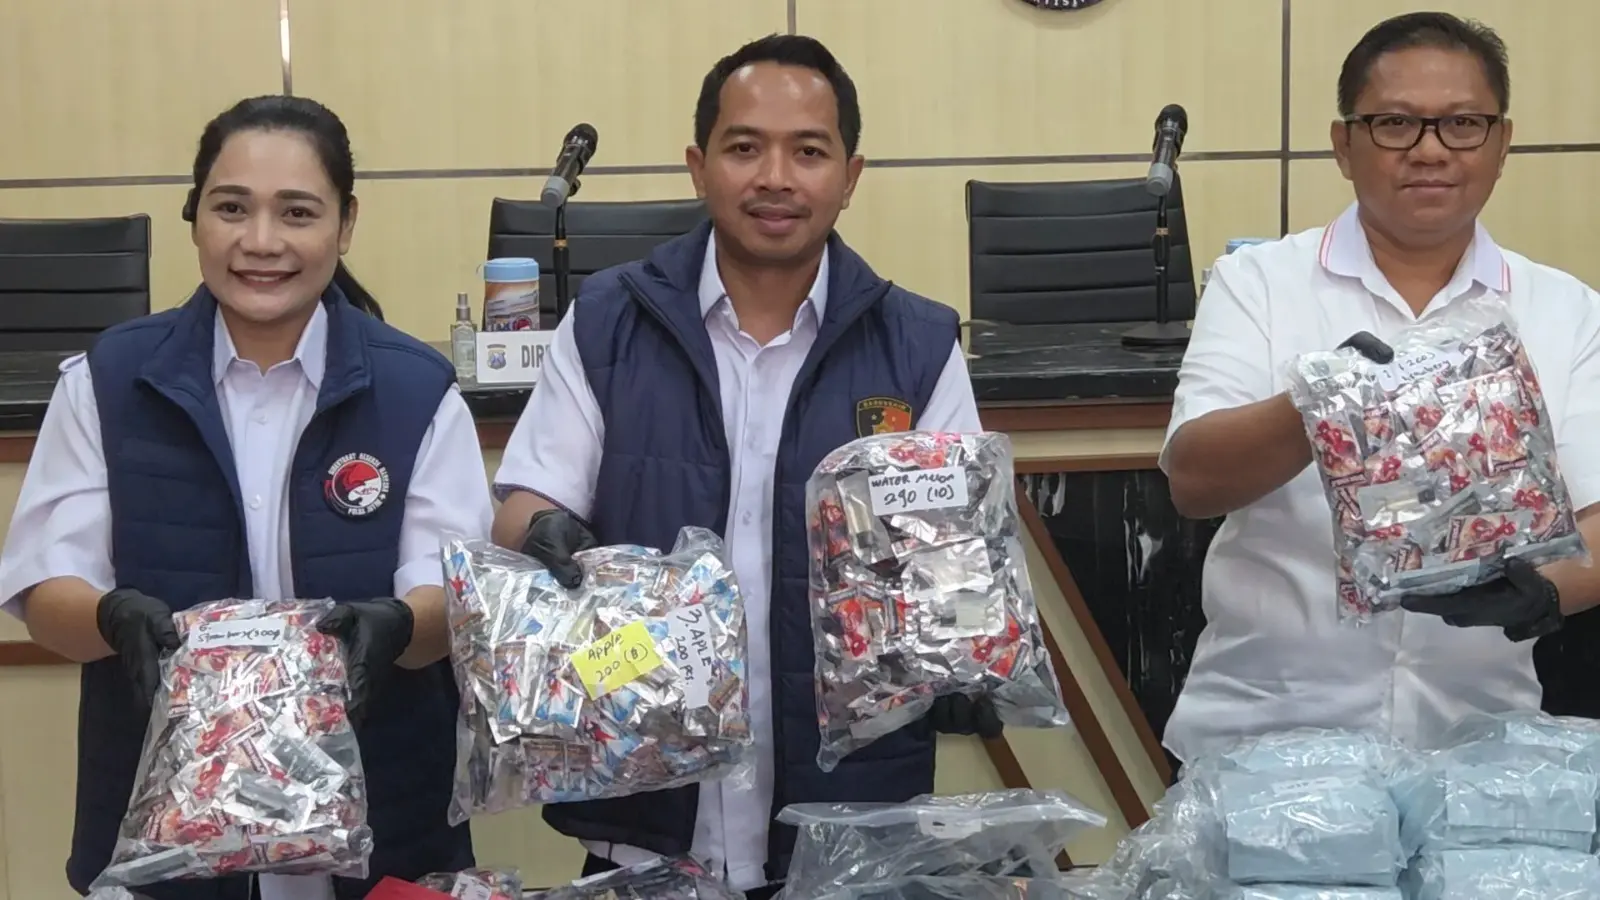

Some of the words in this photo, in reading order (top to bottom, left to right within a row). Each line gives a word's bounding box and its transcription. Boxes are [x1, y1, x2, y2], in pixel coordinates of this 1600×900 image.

[871, 474, 910, 487] WATER
[883, 488, 917, 508] 290
[927, 484, 955, 502] (10)
[676, 608, 703, 627] 3.
[588, 633, 624, 661] Apple
[675, 636, 688, 660] 200
[596, 660, 621, 683] 200
[624, 642, 649, 664] (B)
